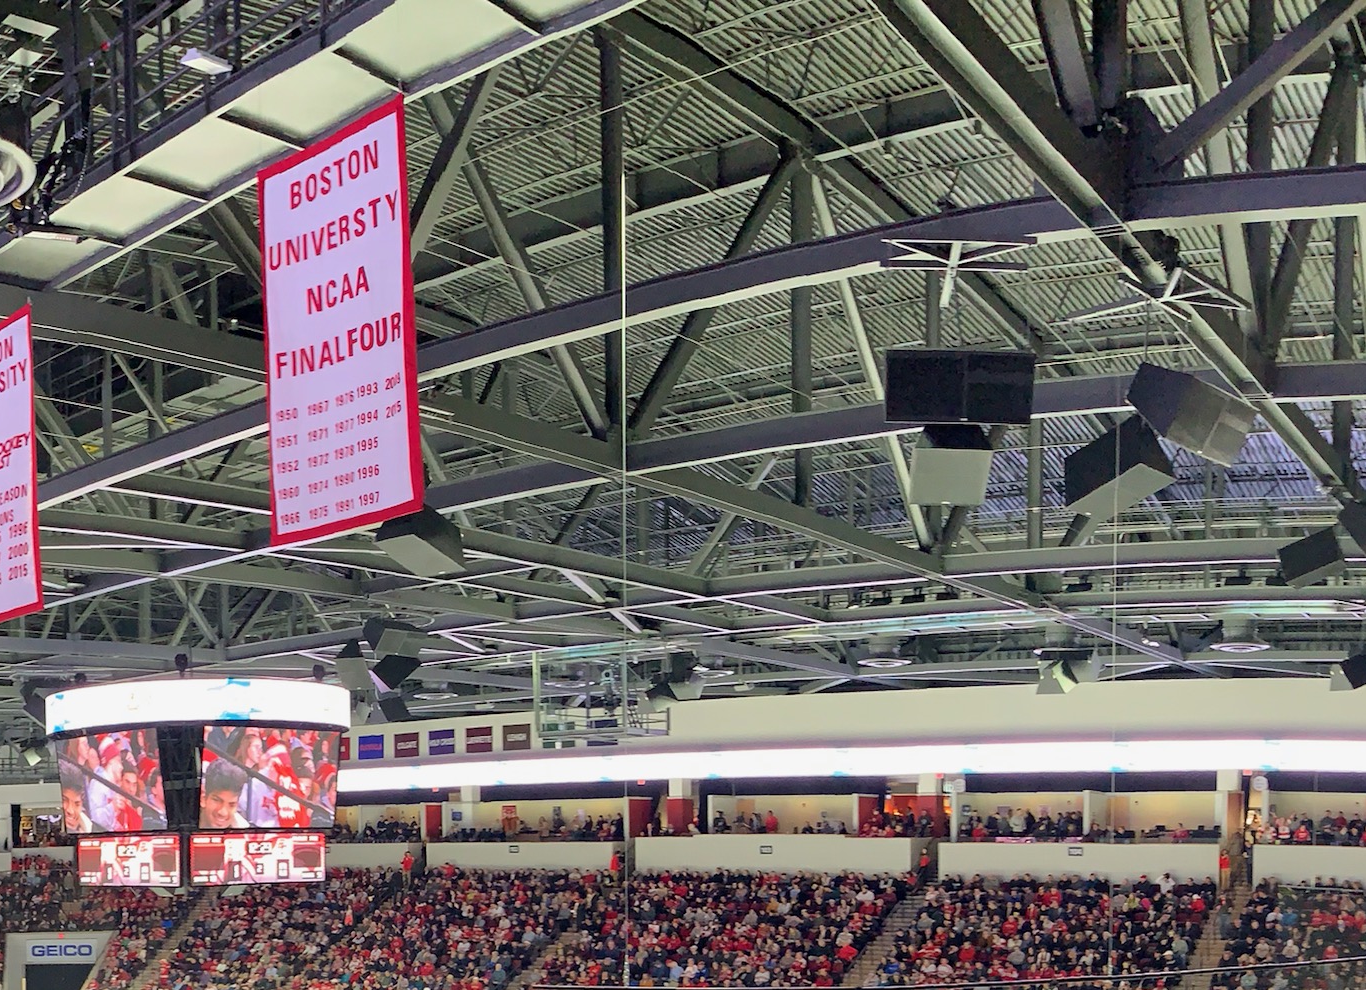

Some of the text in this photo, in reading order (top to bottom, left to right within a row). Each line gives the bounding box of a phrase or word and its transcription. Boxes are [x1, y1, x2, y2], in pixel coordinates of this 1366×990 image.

[290, 140, 378, 210] BOSTON
[269, 190, 398, 271] UNIVERSTY
[307, 266, 370, 315] NCAA
[276, 407, 298, 422] 1950
[307, 400, 329, 416] 1967
[357, 382, 378, 398] 1993
[276, 434, 298, 448] 1951
[307, 427, 328, 442] 1971
[335, 418, 354, 434] 1977
[357, 409, 378, 425] 1994
[277, 459, 299, 474] 1952
[357, 436, 378, 452] 1995
[357, 464, 380, 480] 1996
[358, 491, 380, 507] 1997
[8, 563, 28, 581] 2015
[31, 945, 92, 956] GEICO
